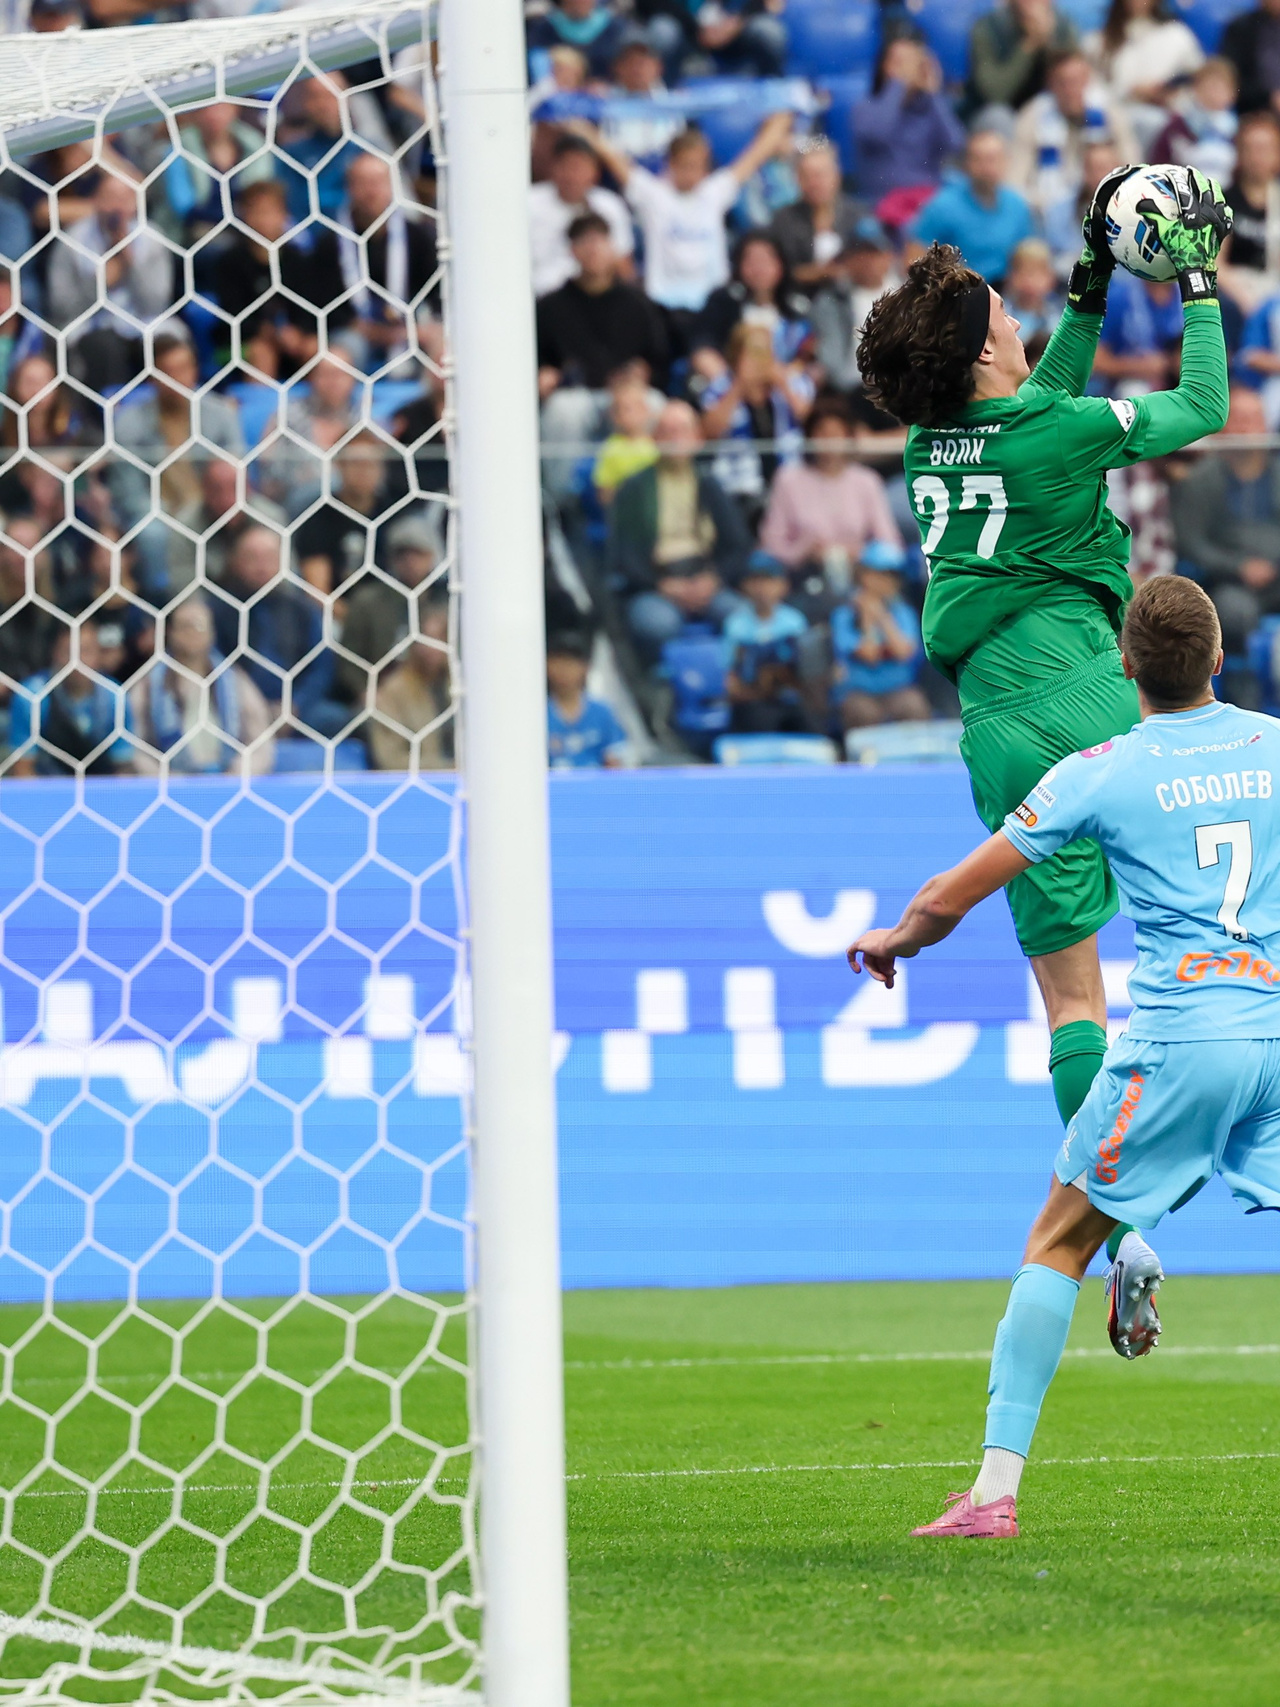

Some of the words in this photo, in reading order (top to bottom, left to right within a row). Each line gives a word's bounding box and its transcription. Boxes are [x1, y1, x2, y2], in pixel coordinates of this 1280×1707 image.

[912, 475, 1009, 578] 27
[1171, 738, 1246, 757] АЭРОФЛОТ
[1155, 769, 1273, 813] СОБОЛЕВ
[1194, 819, 1254, 942] 7
